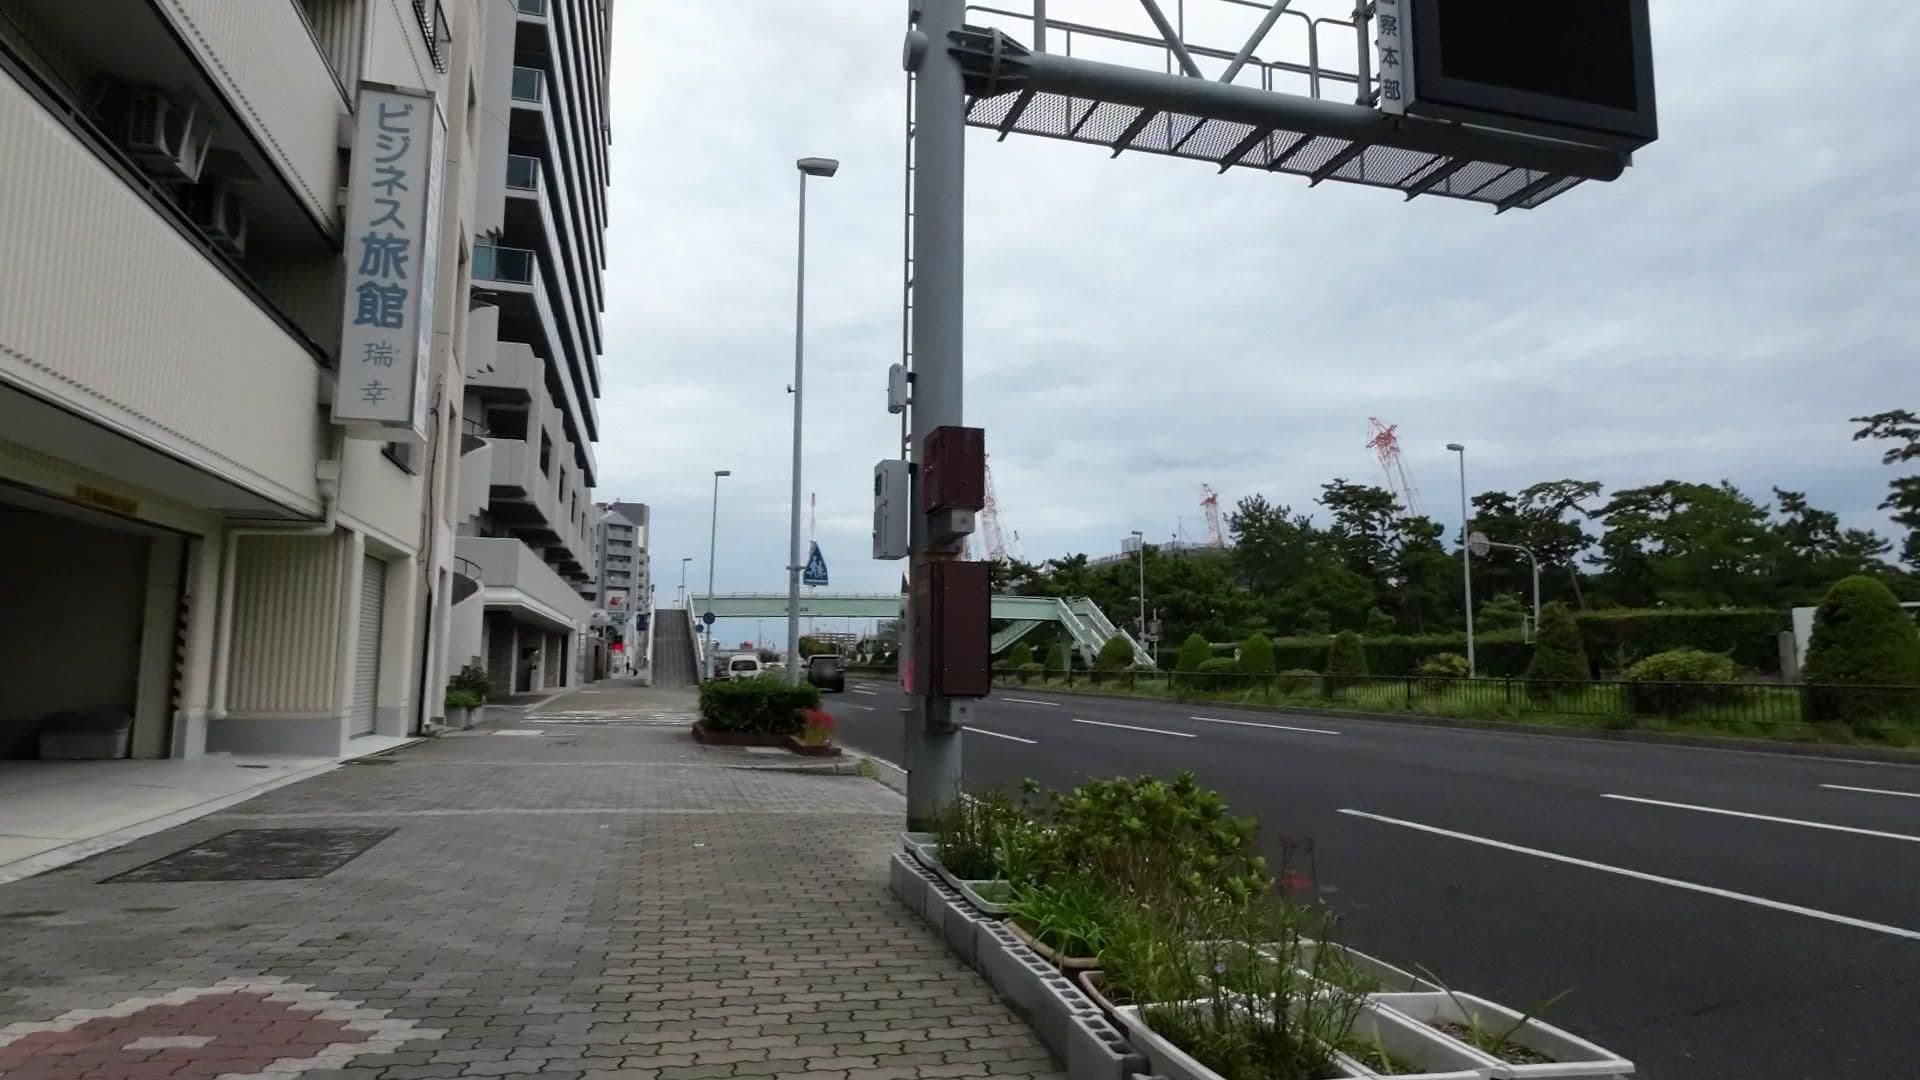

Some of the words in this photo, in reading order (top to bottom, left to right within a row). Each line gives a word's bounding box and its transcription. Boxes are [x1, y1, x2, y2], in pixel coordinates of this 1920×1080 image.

[1380, 0, 1400, 100] 察本部
[353, 102, 414, 329] ビジネス旅館
[360, 341, 394, 406] 瑞幸
